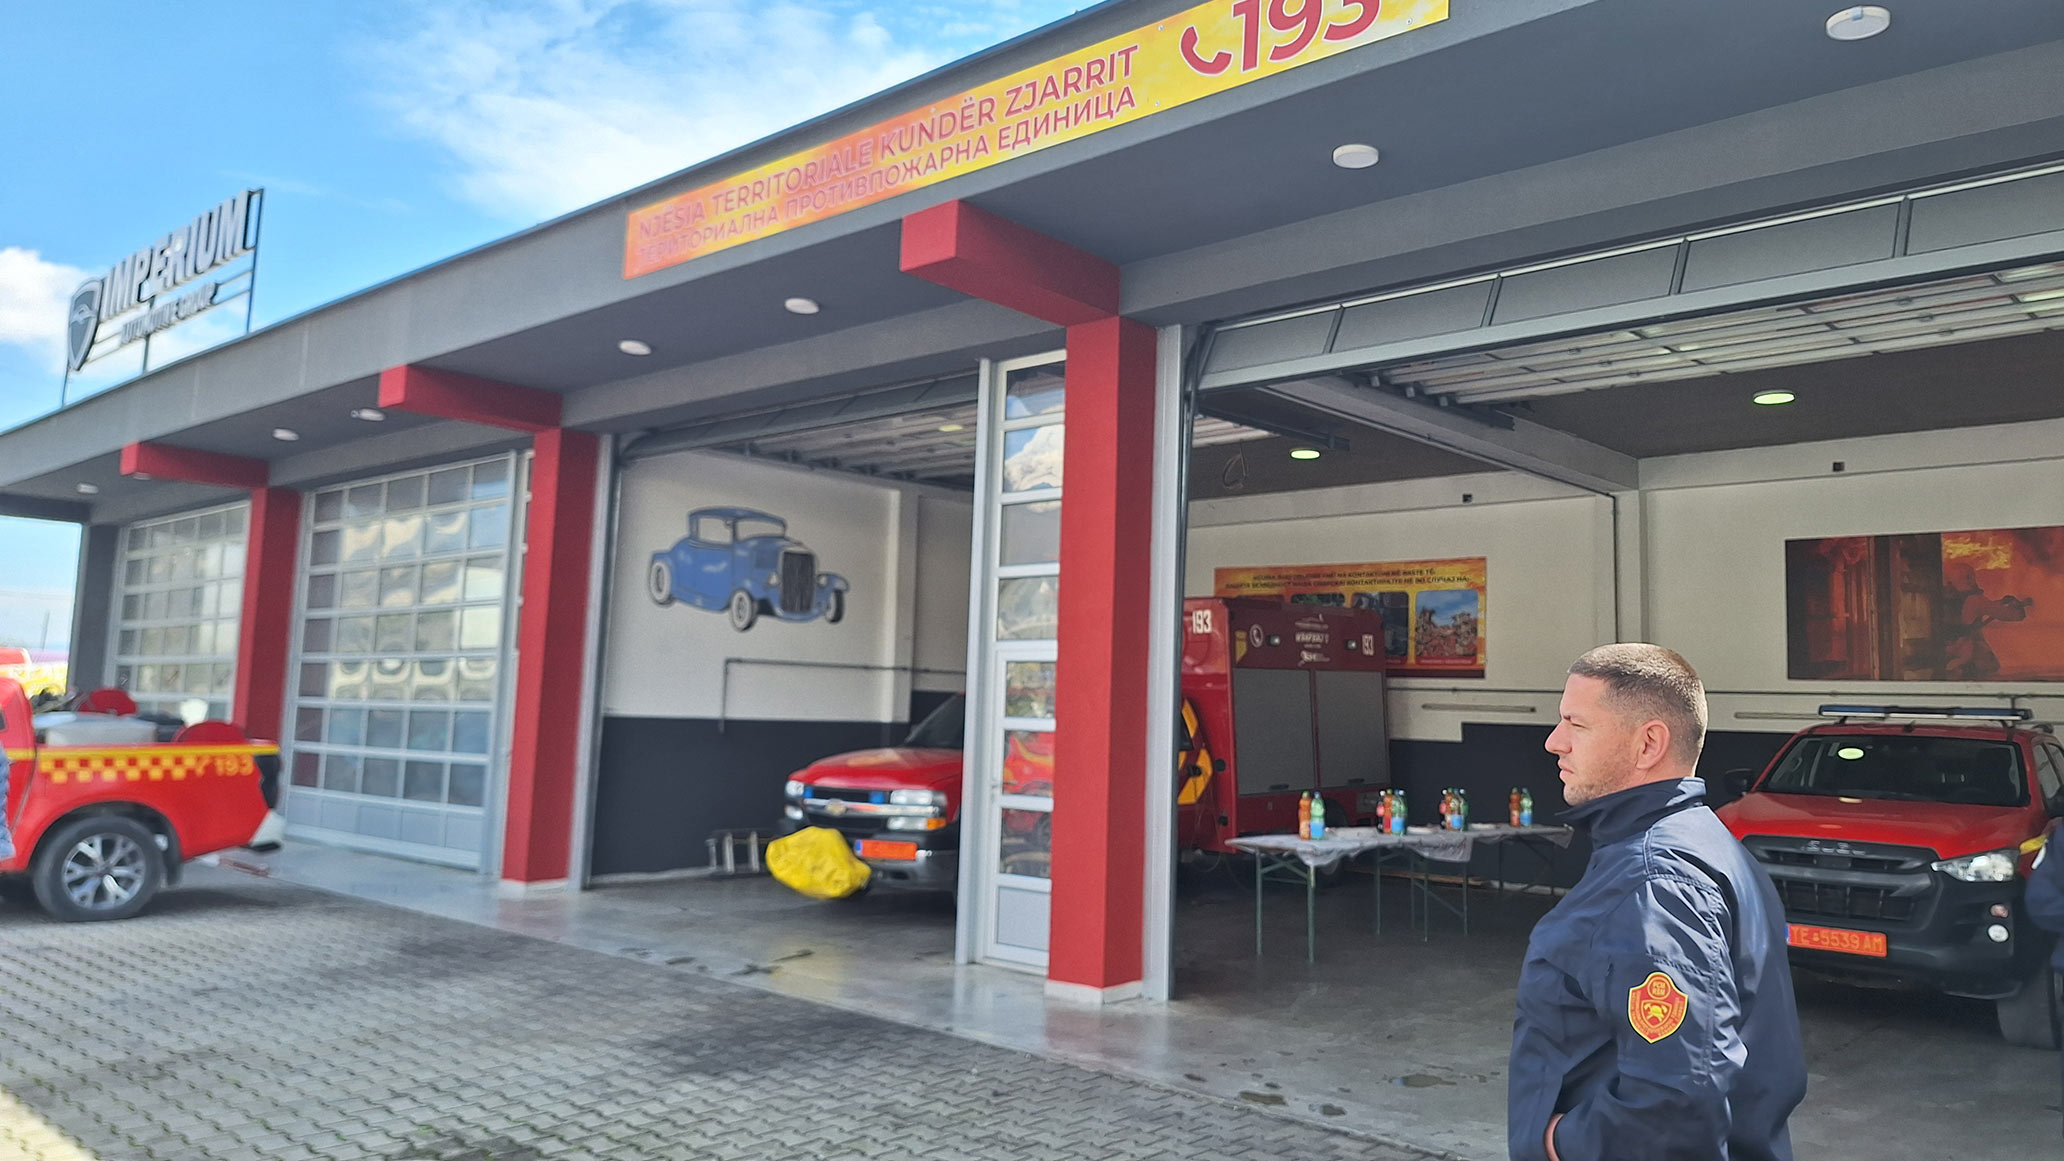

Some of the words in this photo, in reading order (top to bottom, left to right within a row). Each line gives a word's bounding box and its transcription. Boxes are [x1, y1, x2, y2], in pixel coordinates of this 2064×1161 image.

[639, 199, 706, 241] NJËSIA
[711, 139, 874, 217] TERRITORIALE
[880, 96, 997, 161] KUNDËR
[1004, 44, 1139, 118] ZJARRIT
[639, 206, 780, 264] ТЕРИТОРИАЛНА
[785, 134, 990, 219] ПРОТИВПОЖАРНА
[998, 85, 1137, 152] ЕДИНИЦА
[99, 188, 250, 322] IMPERIUM
[1192, 609, 1212, 634] 193
[215, 754, 254, 776] 193
[1820, 930, 1859, 949] 5539
[1863, 936, 1883, 953] AM
